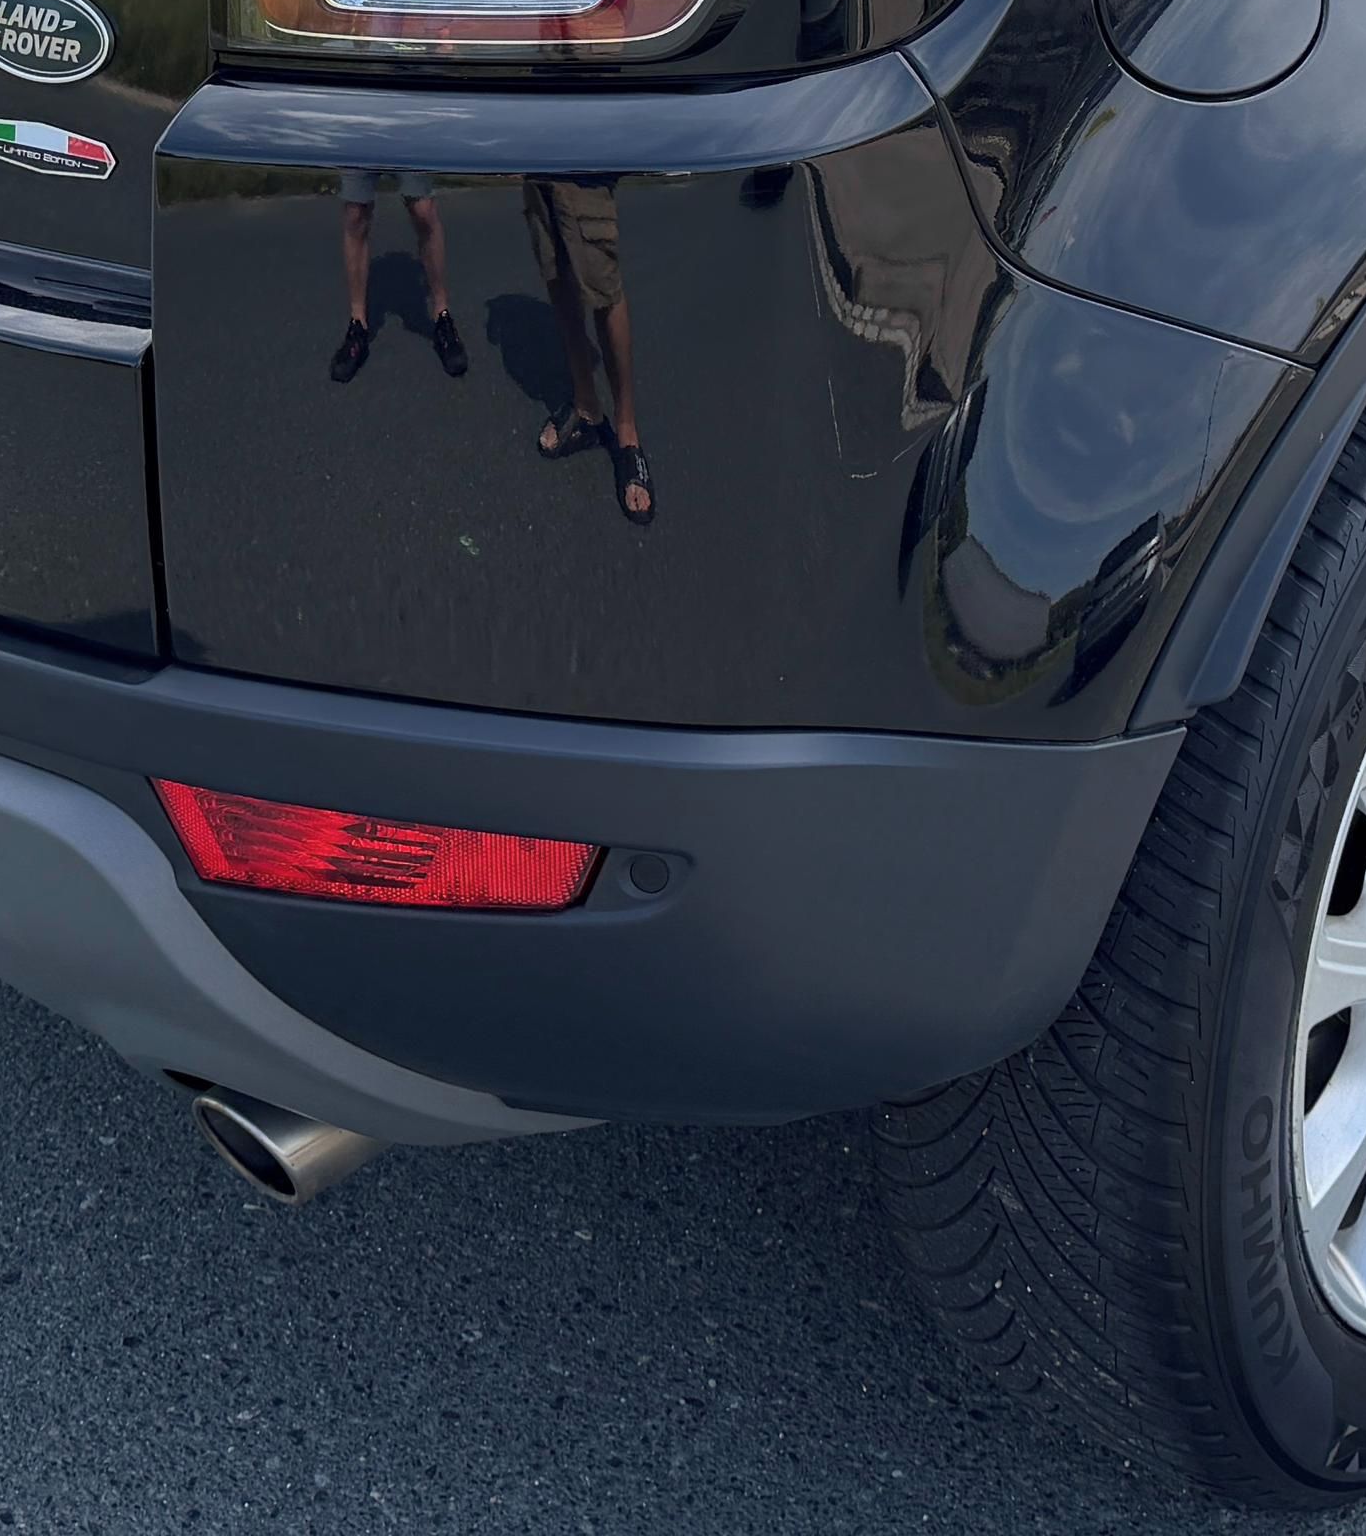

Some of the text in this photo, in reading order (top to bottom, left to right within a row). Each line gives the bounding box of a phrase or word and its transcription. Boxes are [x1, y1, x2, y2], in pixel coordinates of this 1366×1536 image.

[1, 28, 82, 64] ROVER
[3, 144, 82, 169] LIMITED EDITION
[1240, 1094, 1301, 1387] KUMHO
